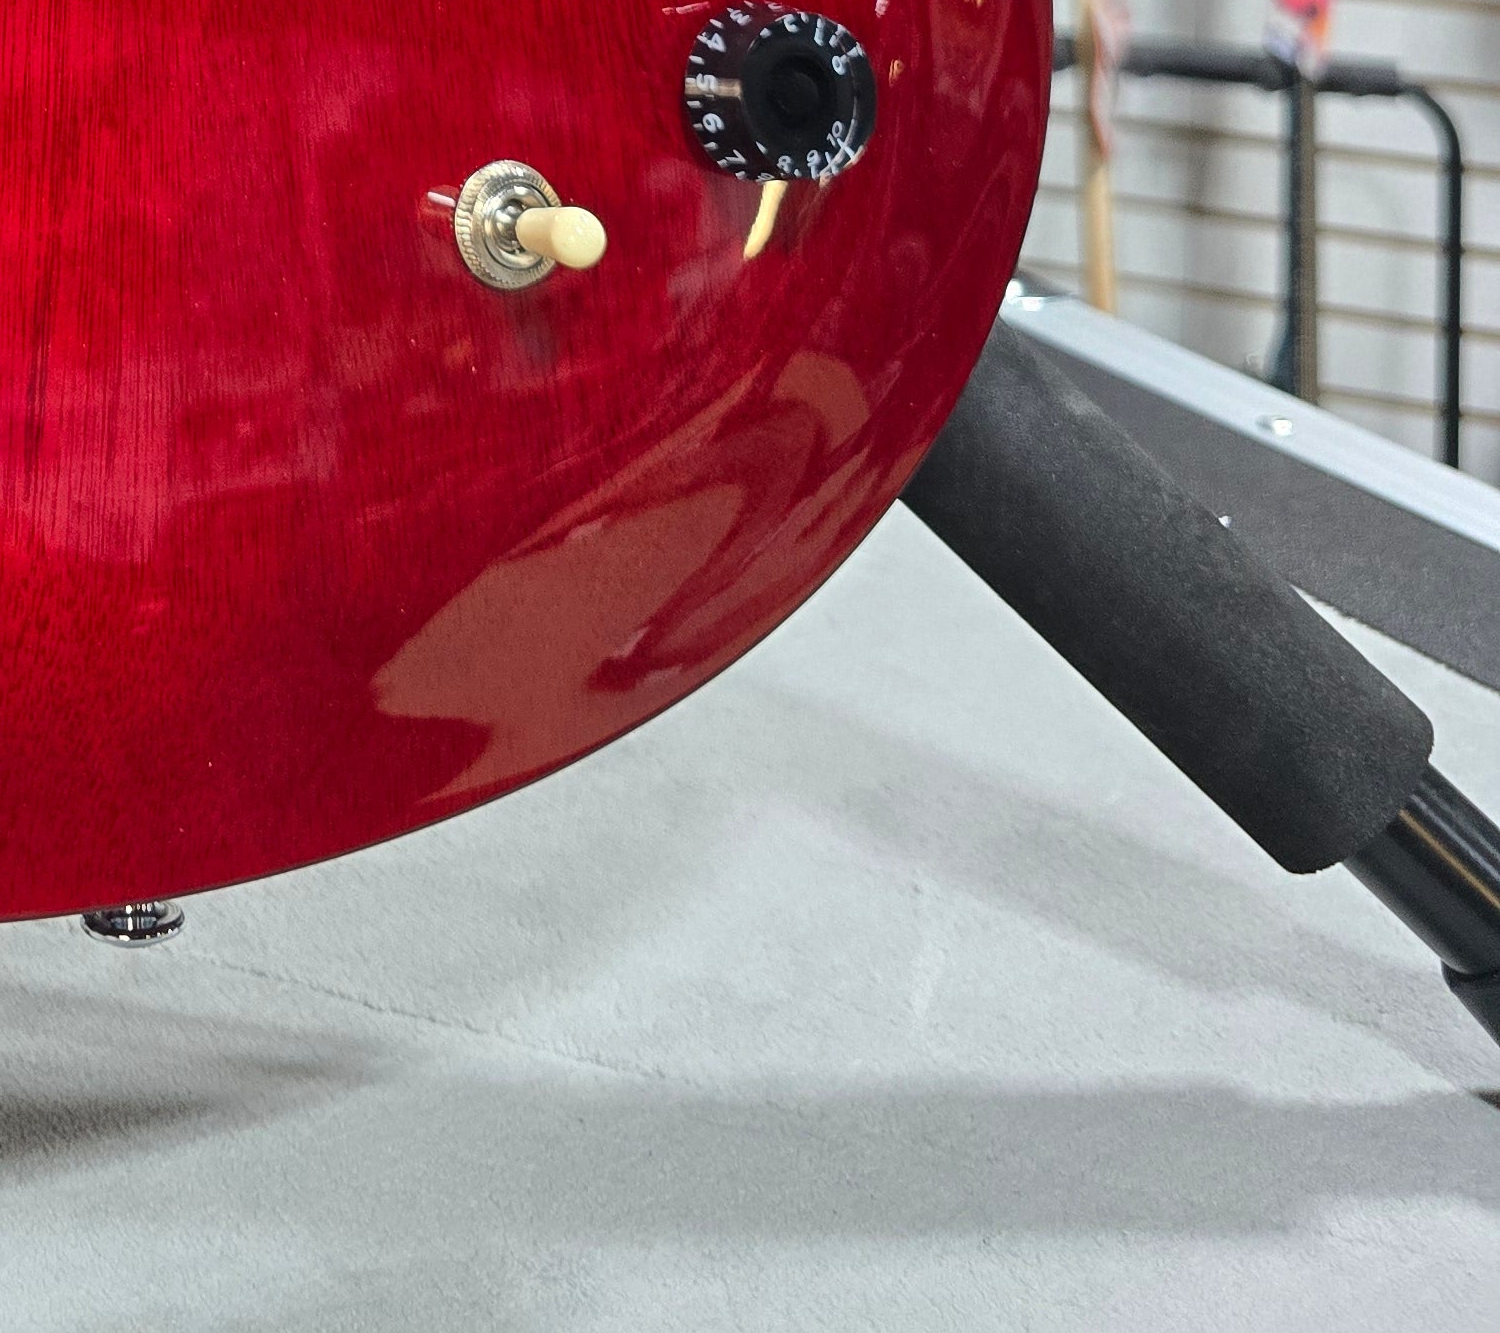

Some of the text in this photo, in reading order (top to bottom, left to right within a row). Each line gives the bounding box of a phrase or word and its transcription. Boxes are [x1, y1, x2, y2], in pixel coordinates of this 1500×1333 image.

[703, 32, 727, 53] 4
[696, 73, 719, 92] 5
[702, 112, 725, 134] 6
[725, 149, 747, 166] 7
